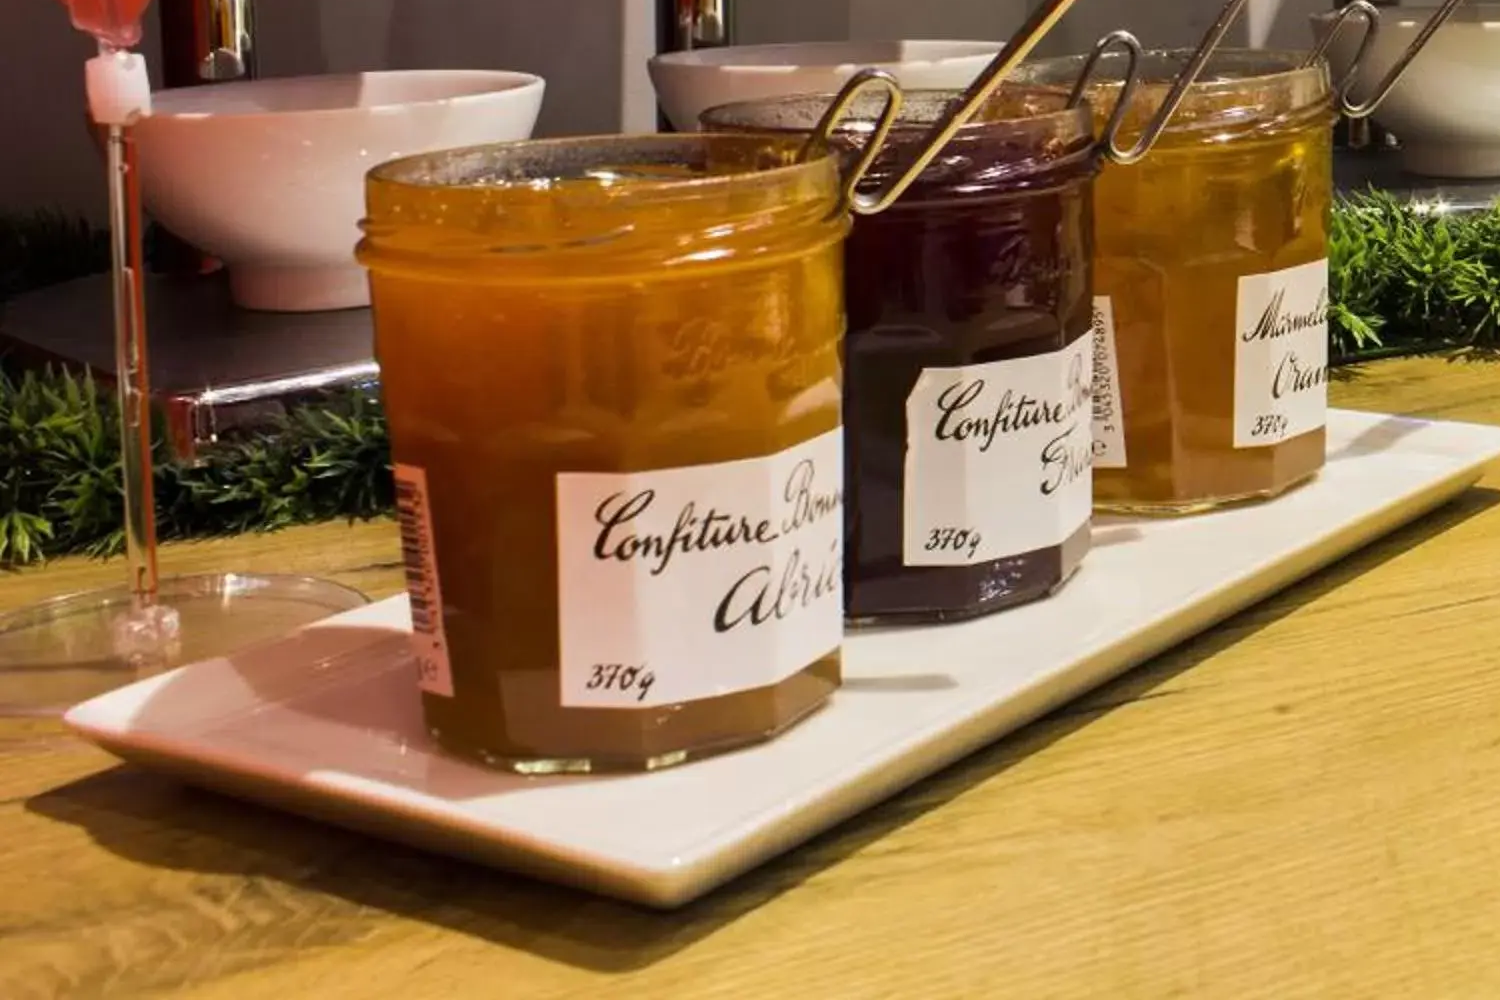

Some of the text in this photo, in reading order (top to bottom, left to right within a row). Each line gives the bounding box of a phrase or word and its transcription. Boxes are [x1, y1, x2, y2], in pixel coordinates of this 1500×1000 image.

[935, 379, 1065, 453] Confiture
[593, 489, 779, 576] Confiture
[924, 526, 983, 559] 370g
[586, 660, 656, 702] 370g
